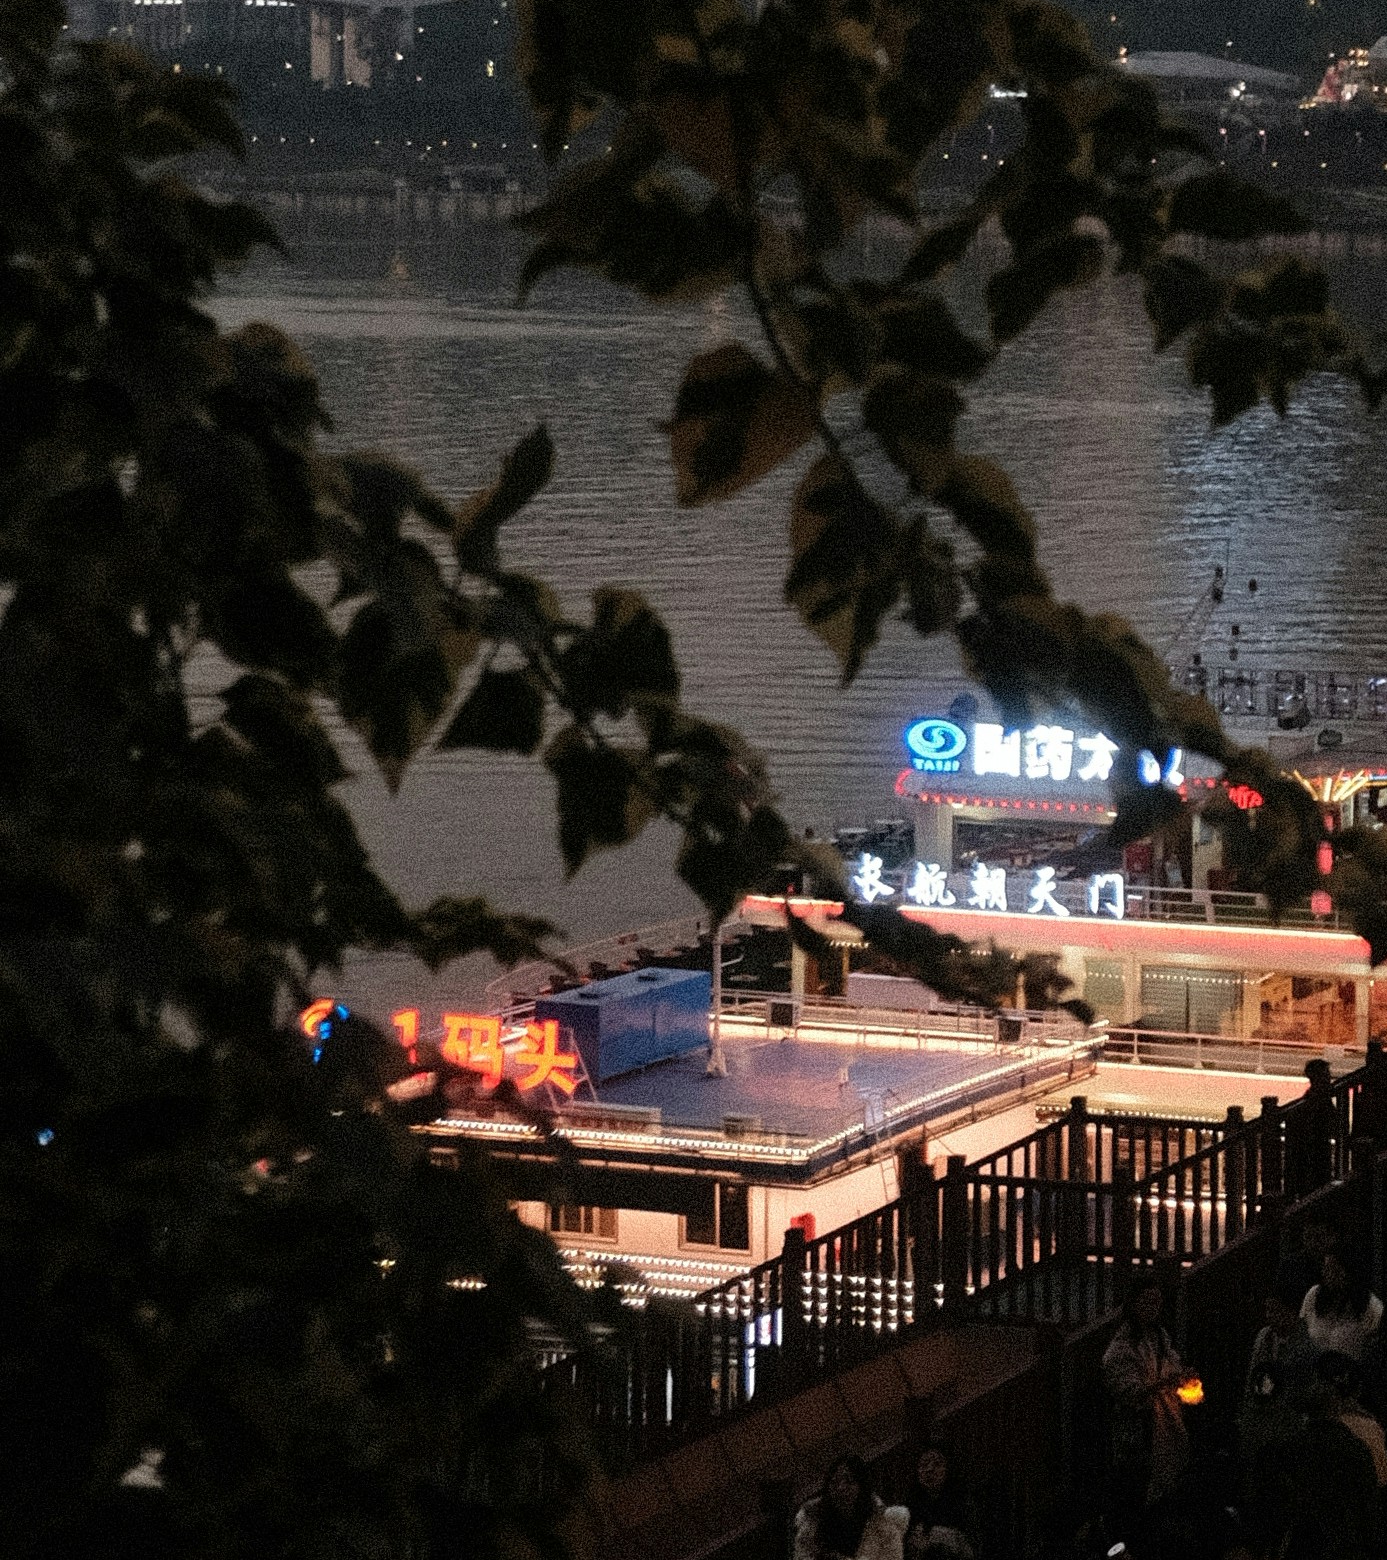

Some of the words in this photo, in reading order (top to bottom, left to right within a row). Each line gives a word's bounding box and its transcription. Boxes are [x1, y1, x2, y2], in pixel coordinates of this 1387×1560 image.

[854, 852, 1125, 920] 长航朝天门
